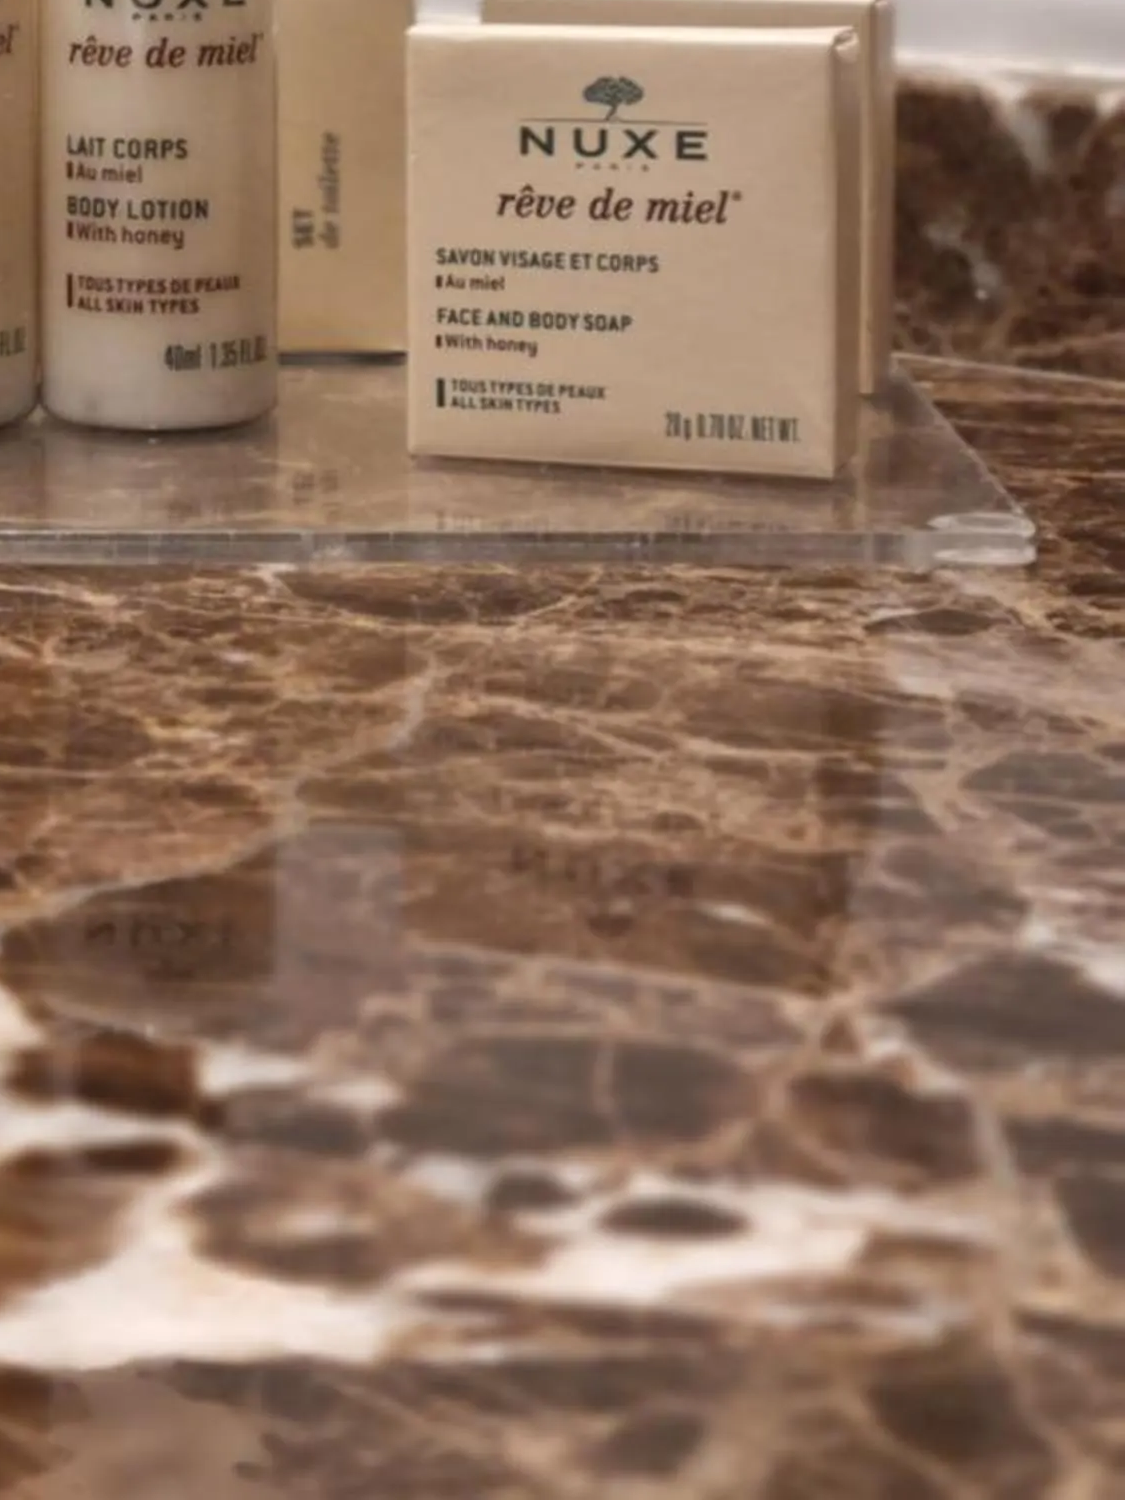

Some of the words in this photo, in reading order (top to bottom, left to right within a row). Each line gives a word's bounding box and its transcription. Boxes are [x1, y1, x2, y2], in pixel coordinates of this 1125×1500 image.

[68, 34, 133, 67] rêve
[145, 36, 186, 68] de
[67, 135, 106, 157] LAIT
[113, 138, 189, 160] CORPS
[519, 126, 708, 161] NUXE
[76, 161, 97, 181] Au
[101, 165, 143, 184] miel
[67, 196, 119, 219] BODY
[127, 199, 210, 221] LOTION
[496, 184, 575, 218] rêve
[588, 187, 633, 221] de
[77, 223, 118, 243] With
[122, 227, 185, 250] honey
[436, 248, 495, 266] SAVON
[499, 251, 566, 270] VISAGE
[570, 253, 592, 270] ET
[596, 254, 660, 273] CORPS
[116, 278, 167, 295] TYPES
[445, 275, 466, 289] Au
[469, 276, 506, 291] miel
[78, 297, 102, 312] ALL
[105, 297, 144, 314] SKIN
[149, 297, 201, 314] TYPES
[437, 308, 482, 326] FACE
[486, 310, 525, 328] AND
[529, 311, 580, 330] BODY
[583, 314, 633, 332] SOAP
[445, 334, 483, 350] With
[486, 337, 538, 358] honey
[451, 378, 487, 394] TOUS
[489, 380, 533, 396] TYPES
[536, 383, 555, 397] DE
[558, 384, 606, 400] PEAUX
[450, 396, 475, 410] ALL
[478, 397, 513, 411] SKIN
[516, 399, 561, 414] TYPES
